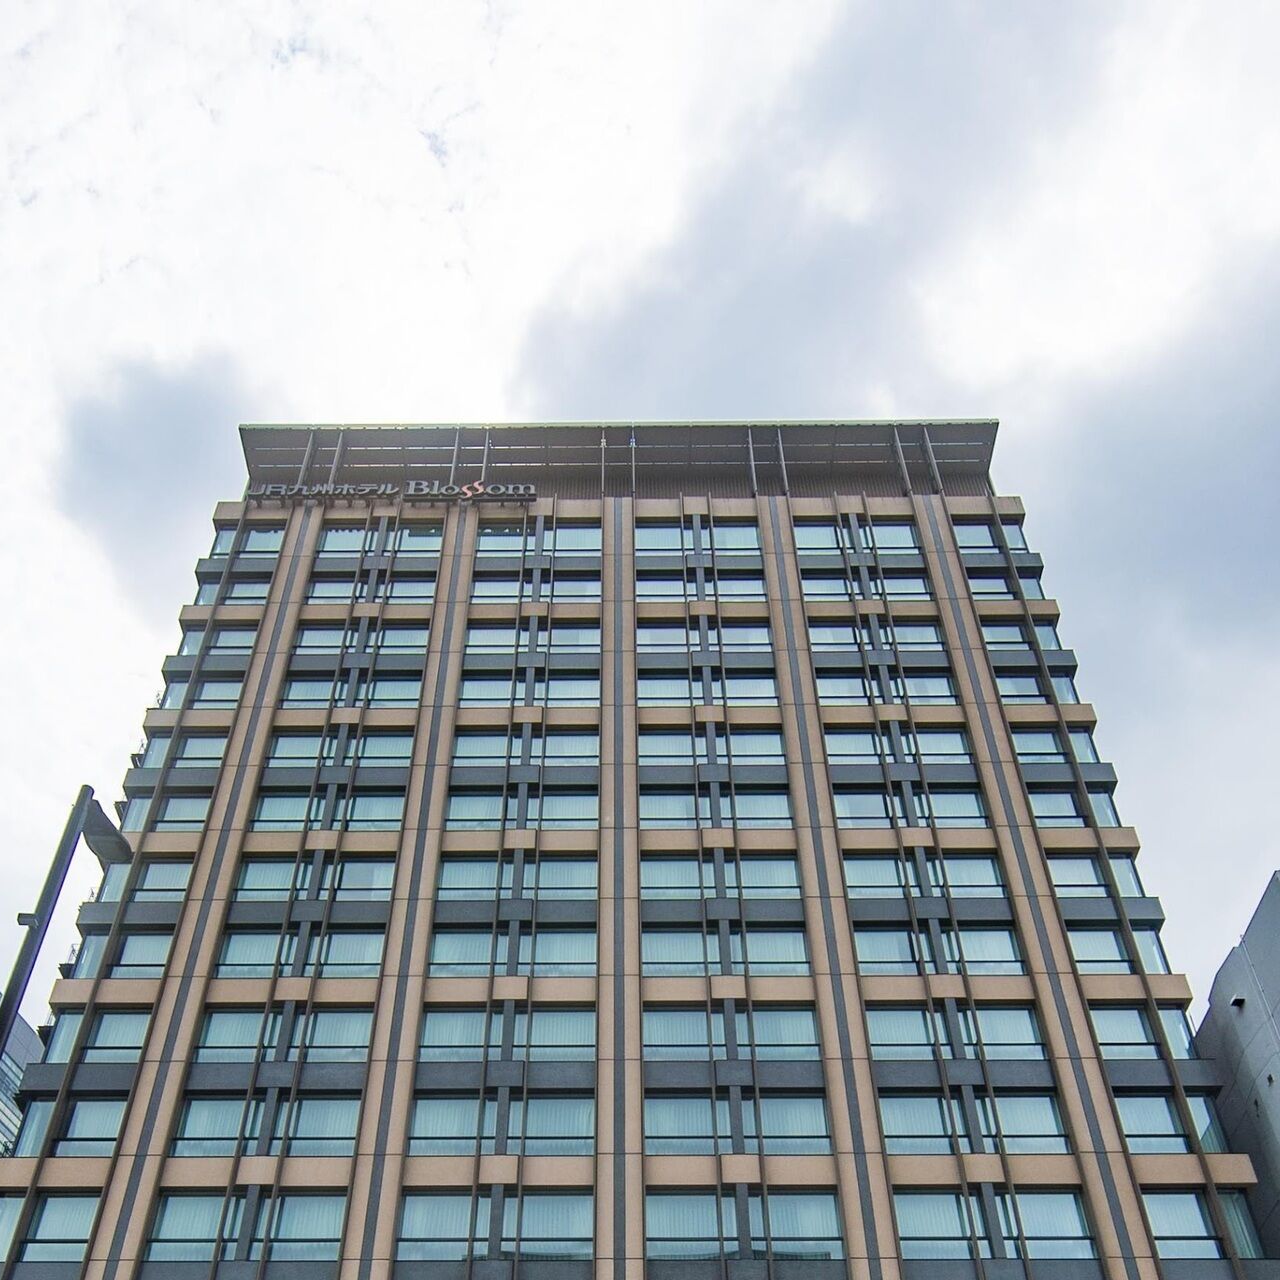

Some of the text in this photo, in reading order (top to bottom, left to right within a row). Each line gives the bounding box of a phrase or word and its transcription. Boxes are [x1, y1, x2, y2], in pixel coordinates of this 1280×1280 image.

[248, 480, 536, 498] JR九州ホテル Blossom
